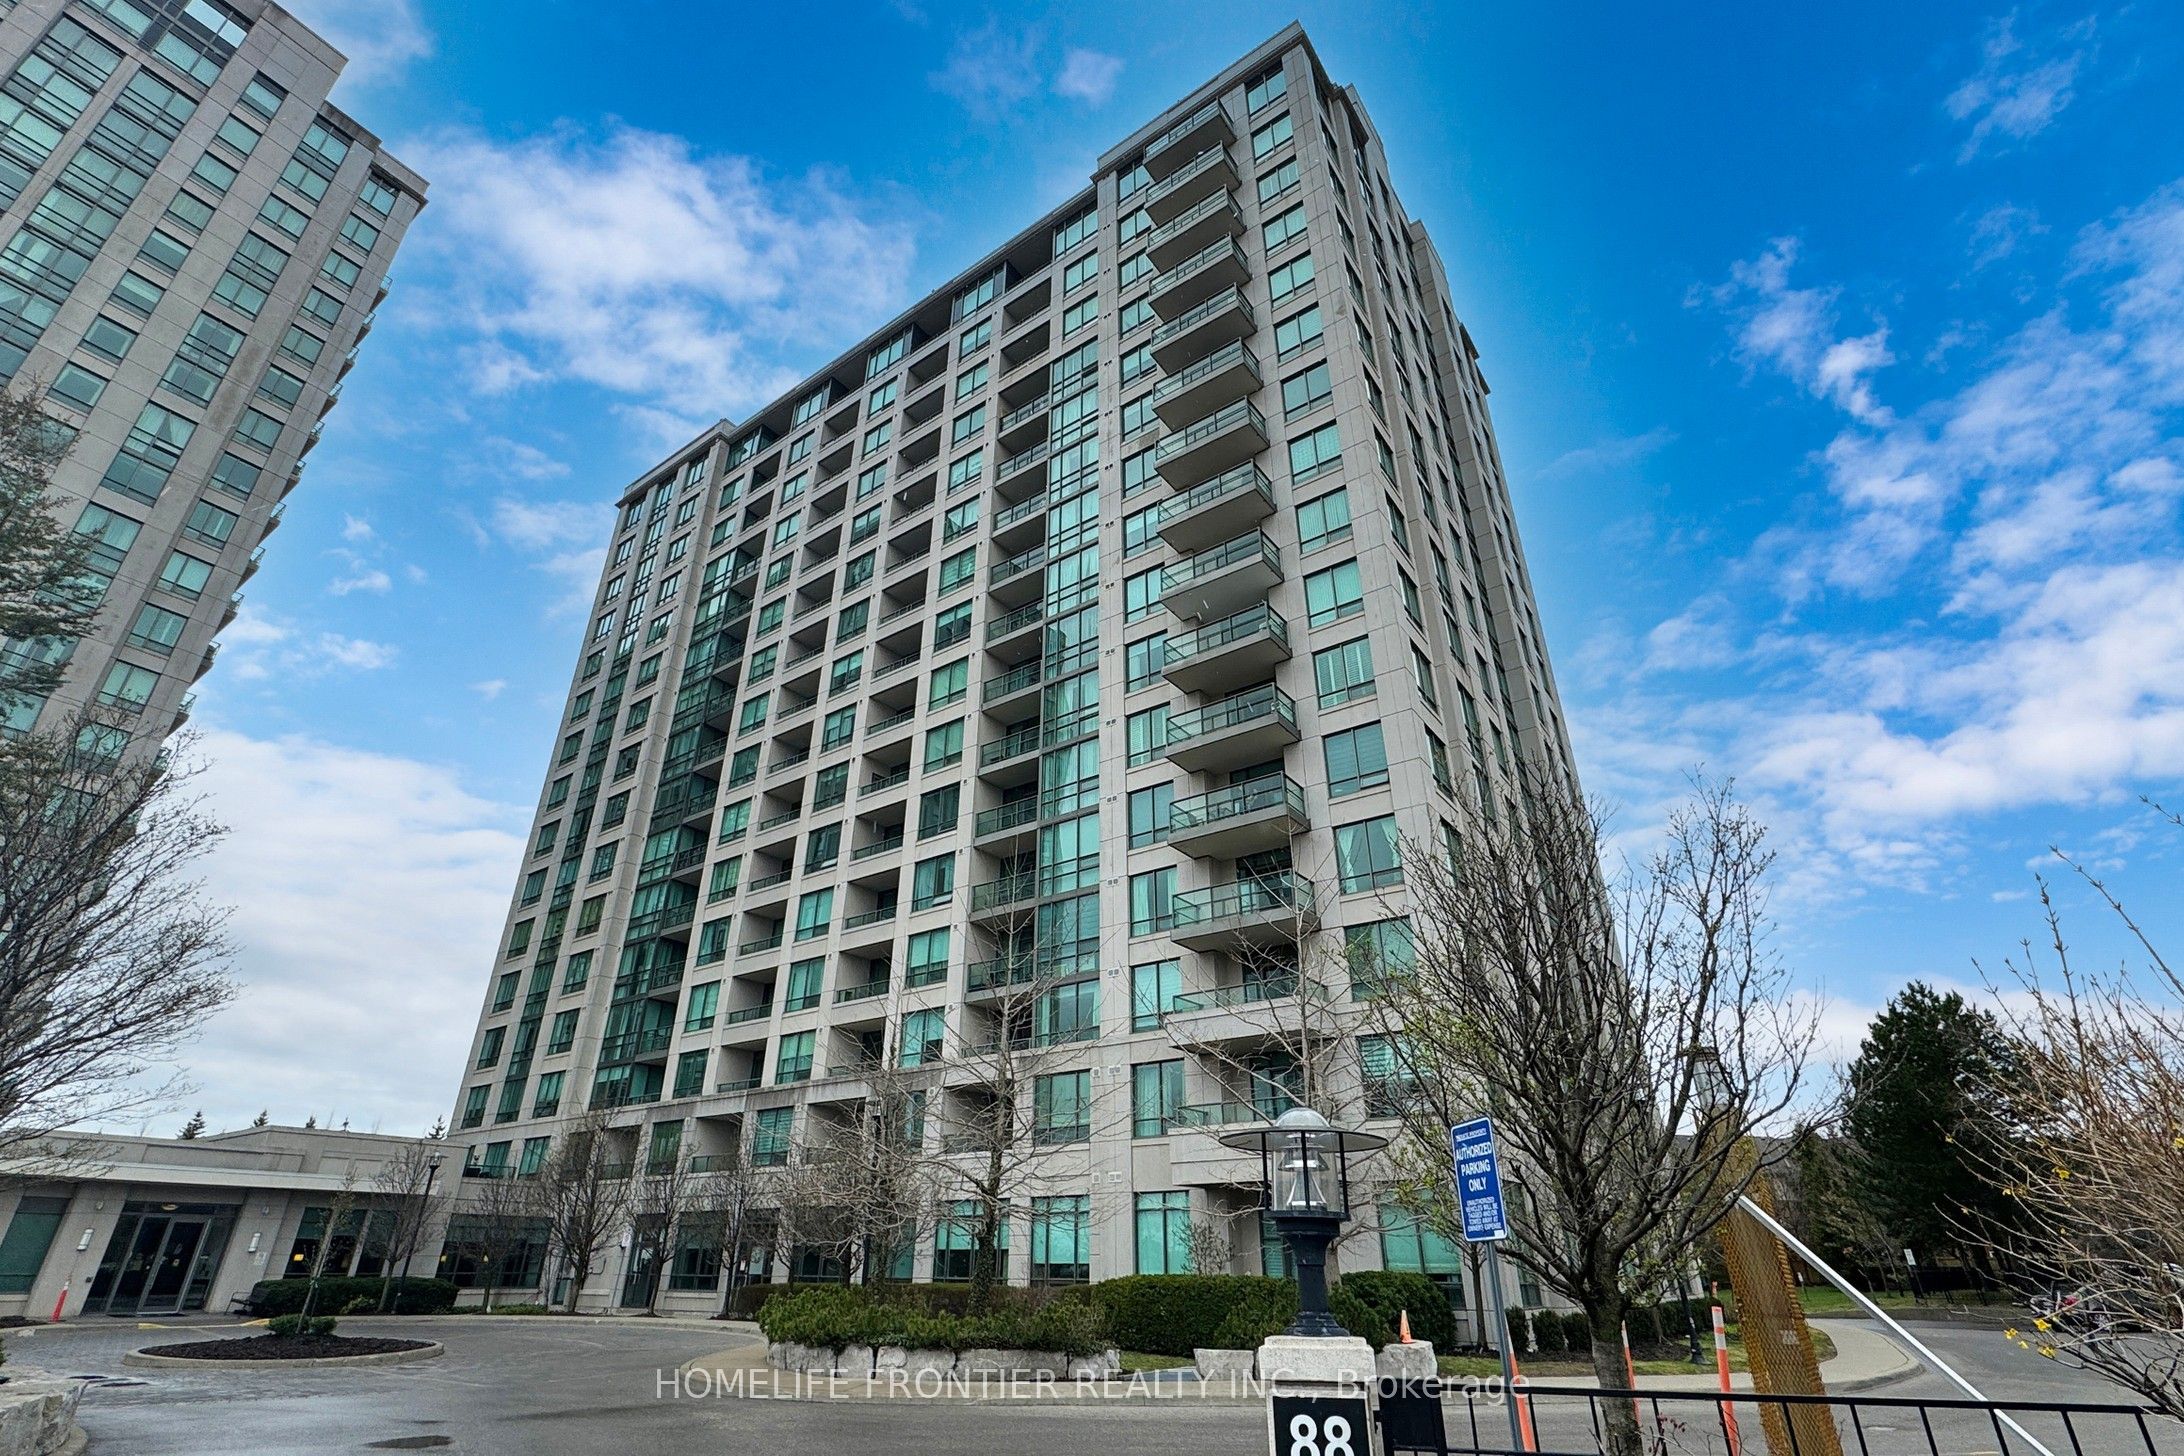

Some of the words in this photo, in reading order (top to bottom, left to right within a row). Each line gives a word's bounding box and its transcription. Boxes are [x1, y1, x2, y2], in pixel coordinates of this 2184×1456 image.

[1456, 1142, 1492, 1160] AUTHORIZED
[1461, 1159, 1491, 1176] PARKING
[1468, 1176, 1487, 1192] ONLY
[1290, 1414, 1355, 1456] 88
